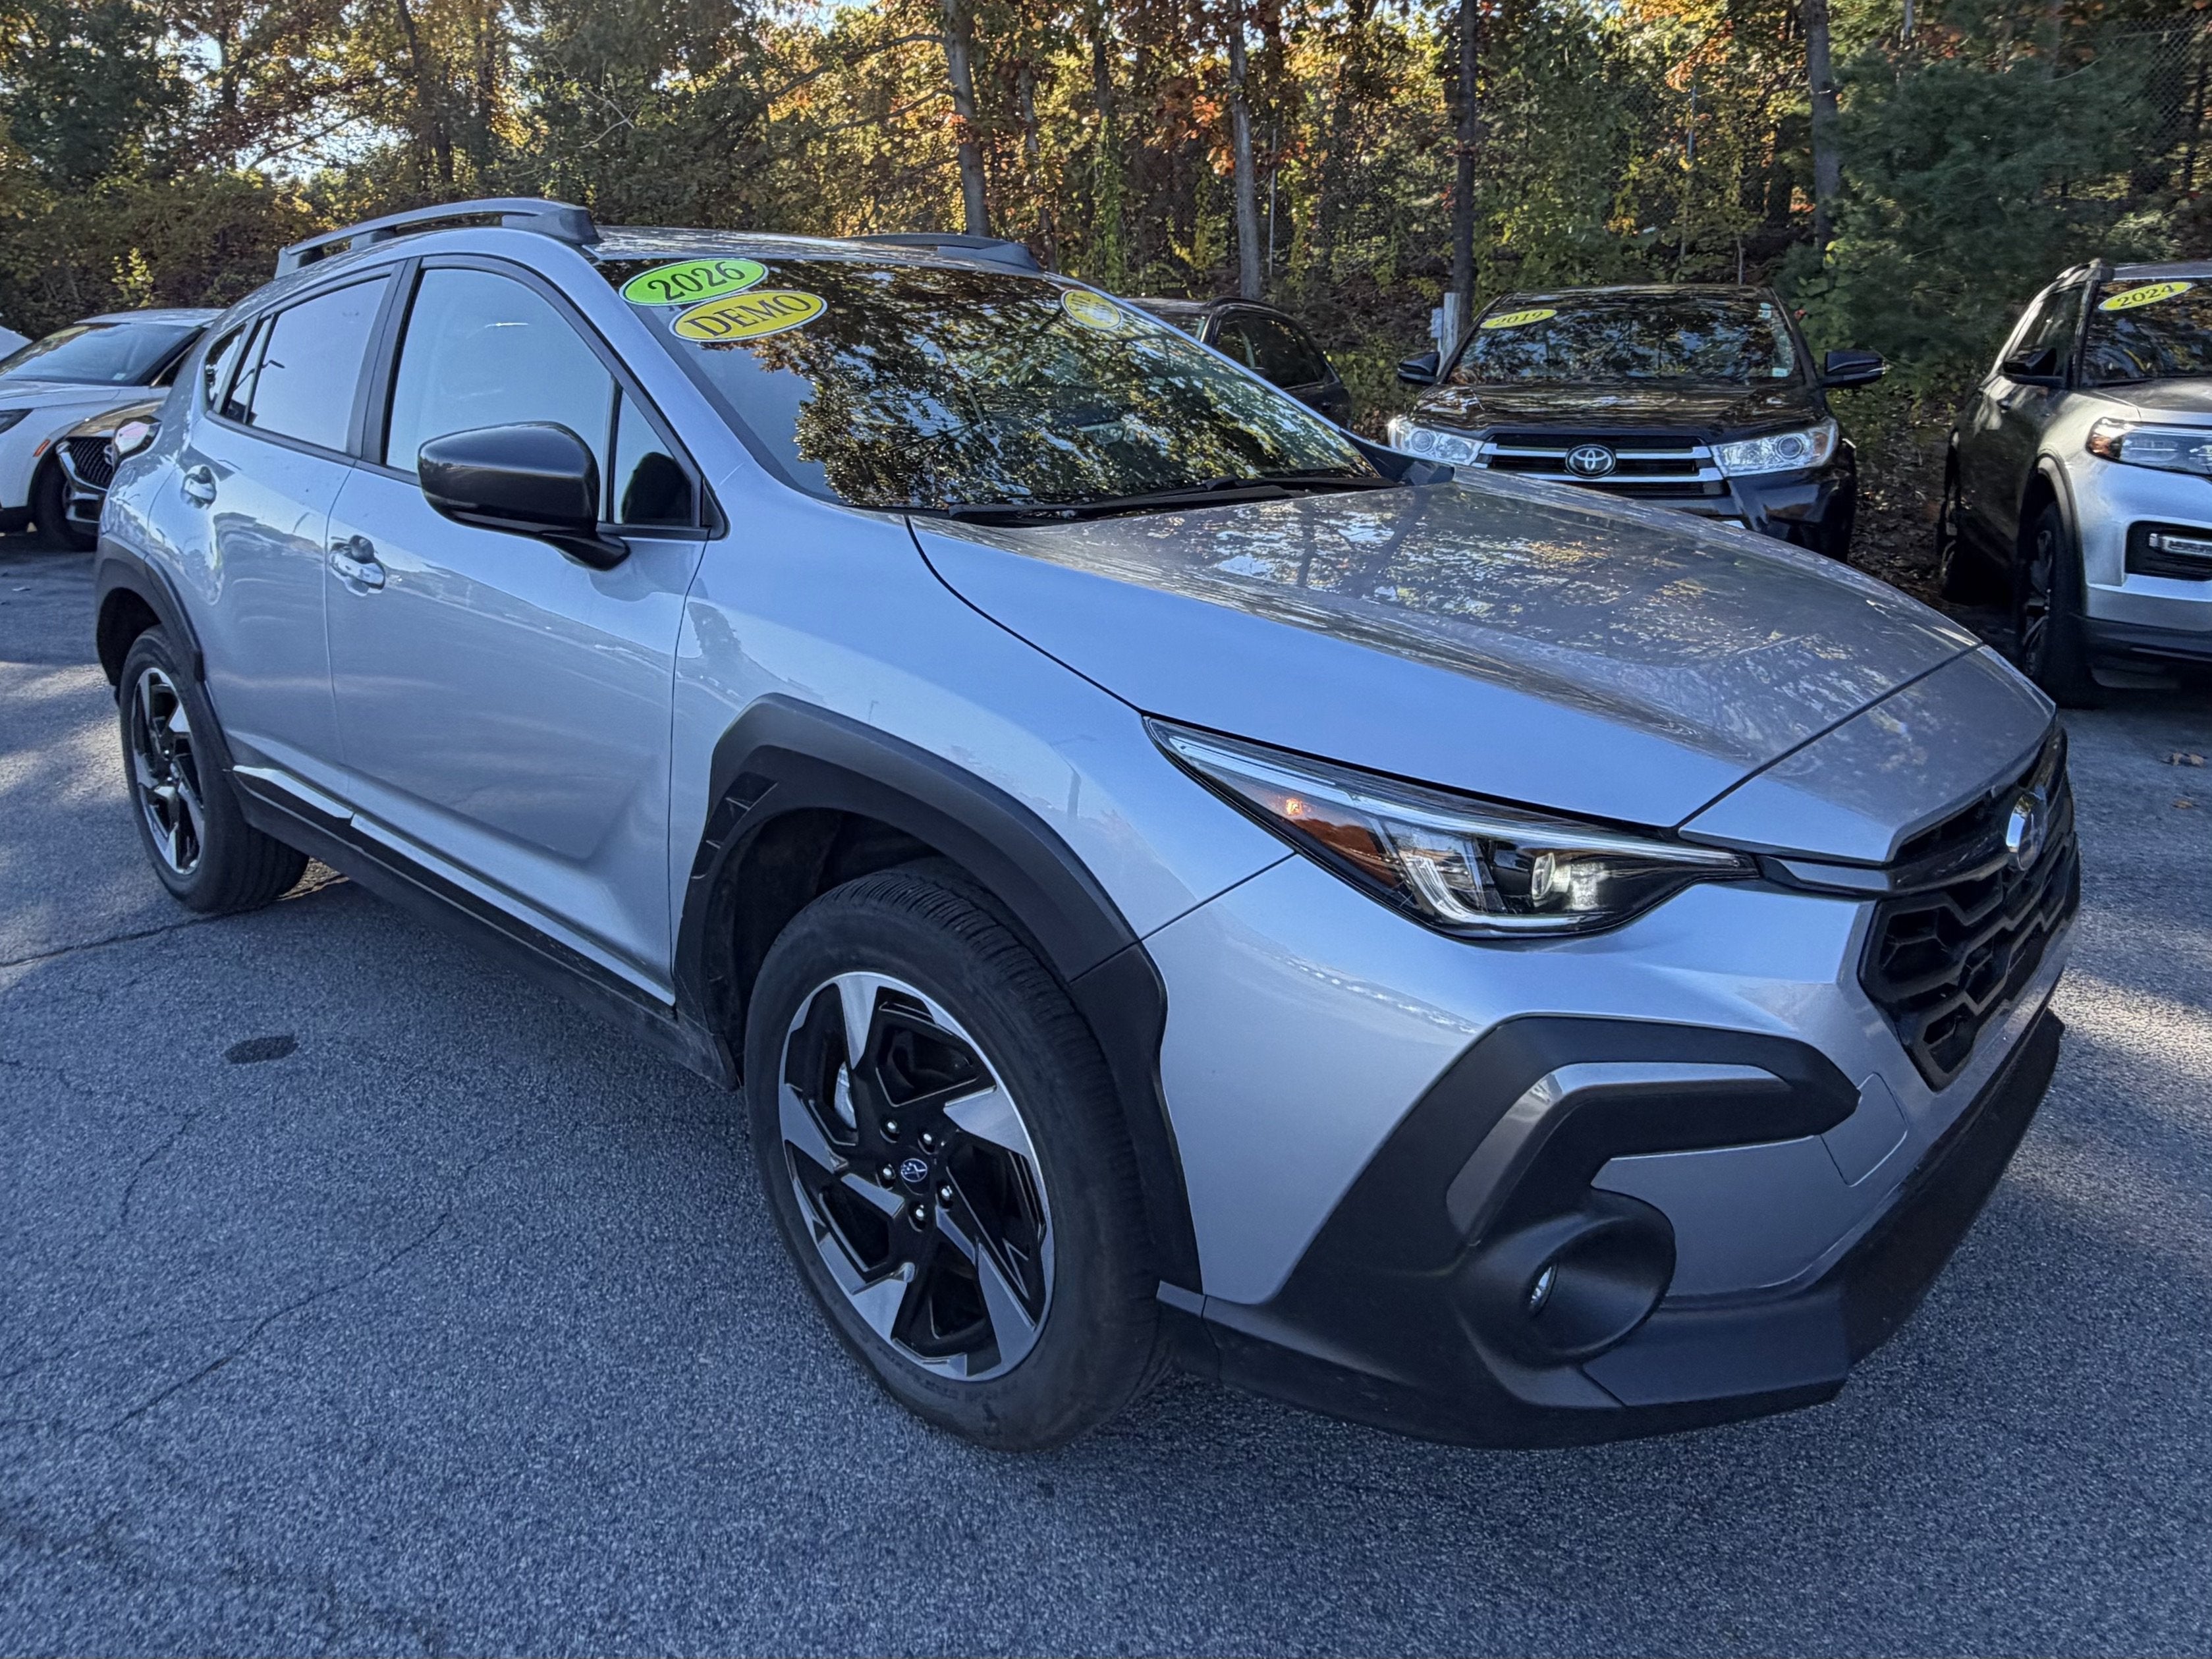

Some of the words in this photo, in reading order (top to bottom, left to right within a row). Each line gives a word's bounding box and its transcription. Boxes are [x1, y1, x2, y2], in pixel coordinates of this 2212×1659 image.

[648, 261, 745, 301] 2026
[2117, 285, 2174, 307] 2024
[683, 294, 812, 337] DEMO
[1494, 311, 1543, 326] 2019
